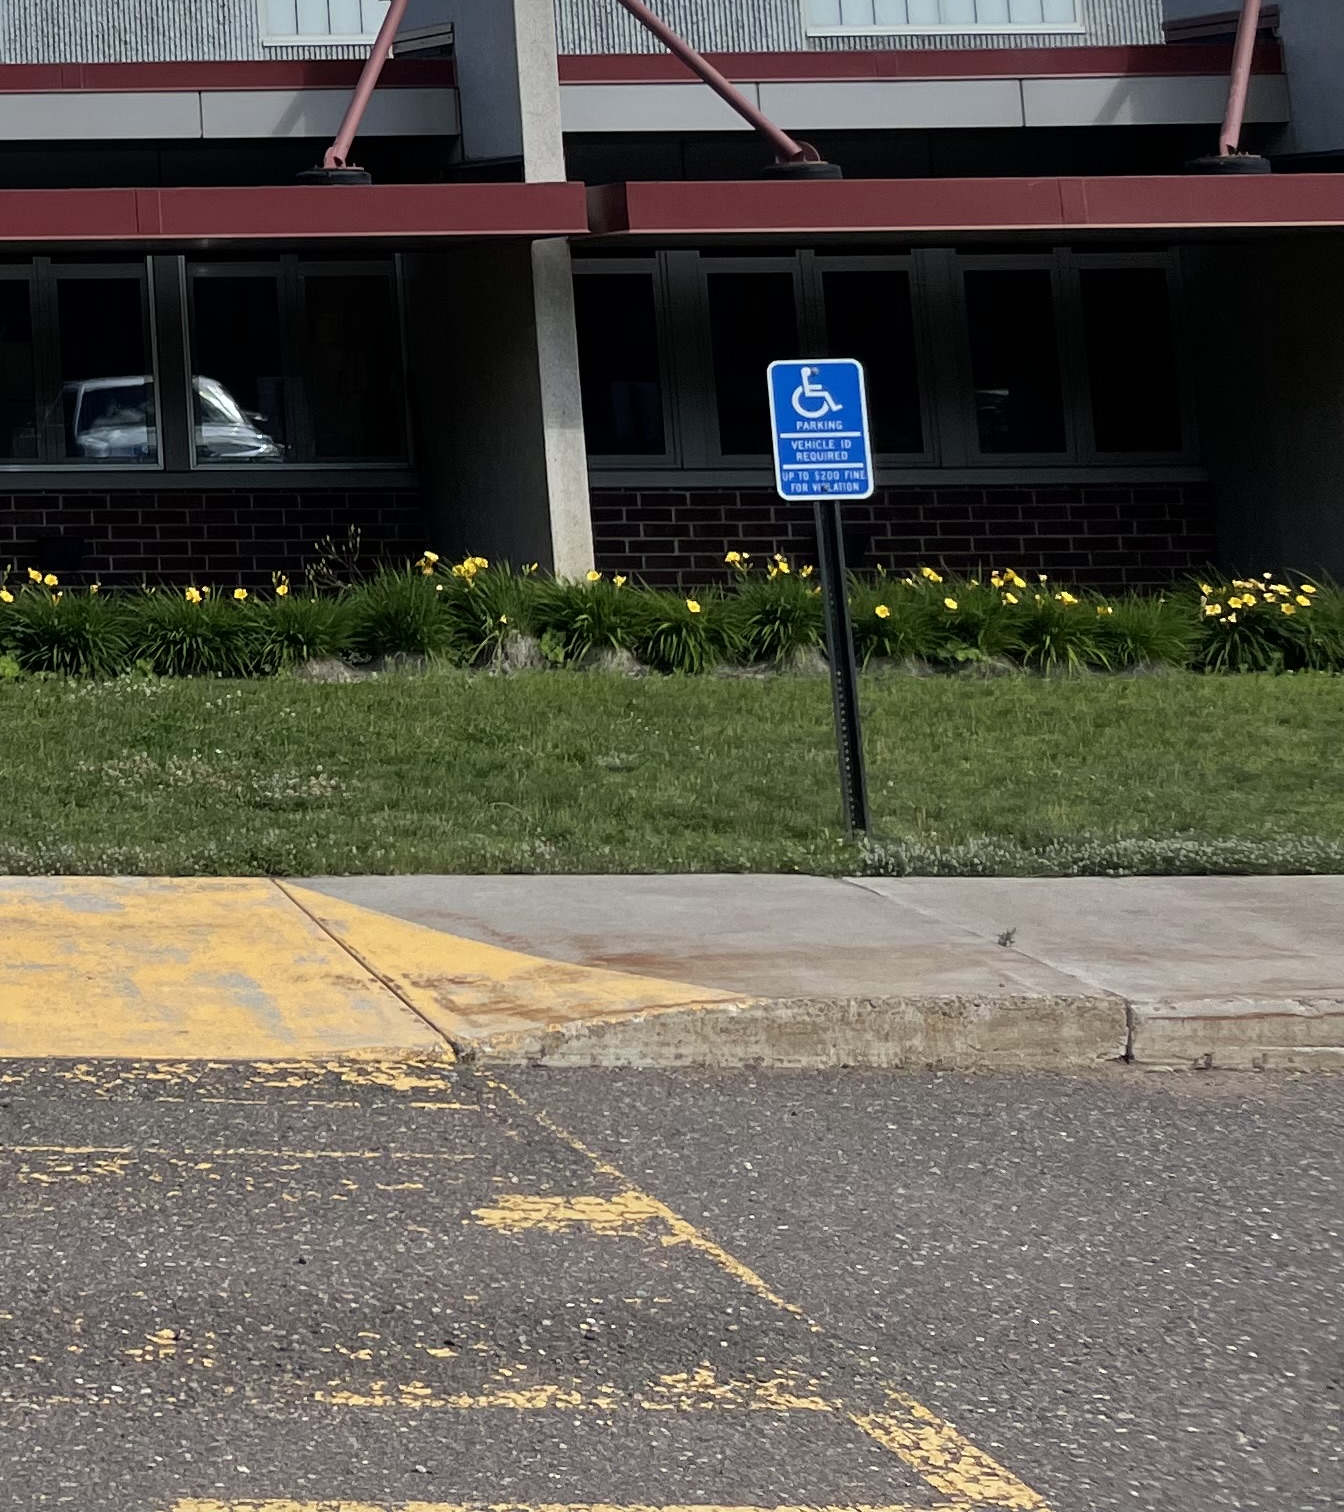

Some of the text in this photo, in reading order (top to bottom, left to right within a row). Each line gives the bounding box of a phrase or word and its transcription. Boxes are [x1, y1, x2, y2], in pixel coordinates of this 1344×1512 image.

[796, 421, 843, 430] PARKING
[791, 439, 852, 450] VEHICLE ID
[796, 451, 848, 461] REQUIRED
[782, 470, 866, 481] UP TO $200 FINE
[790, 482, 860, 493] FOR VILATION
